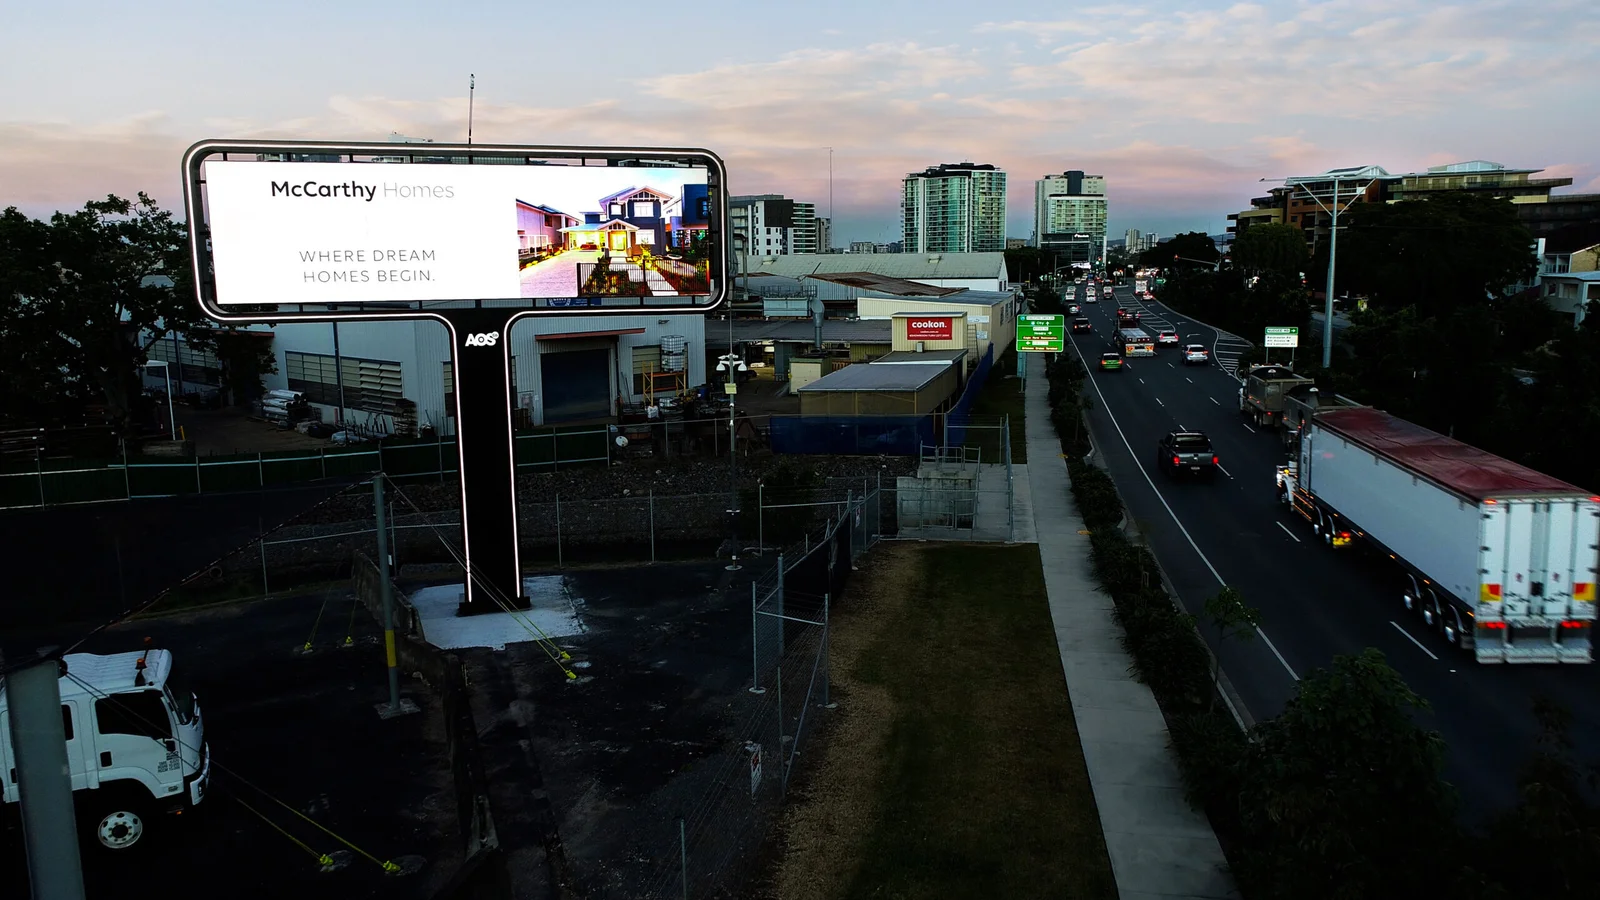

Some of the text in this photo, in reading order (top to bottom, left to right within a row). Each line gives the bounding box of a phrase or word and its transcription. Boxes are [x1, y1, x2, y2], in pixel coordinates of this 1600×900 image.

[271, 180, 455, 202] McCarthy Homes
[299, 249, 436, 262] WHERE DREAM
[303, 269, 436, 283] HOMES BEGIN.
[911, 320, 948, 328] cookon.
[464, 332, 497, 347] AOS
